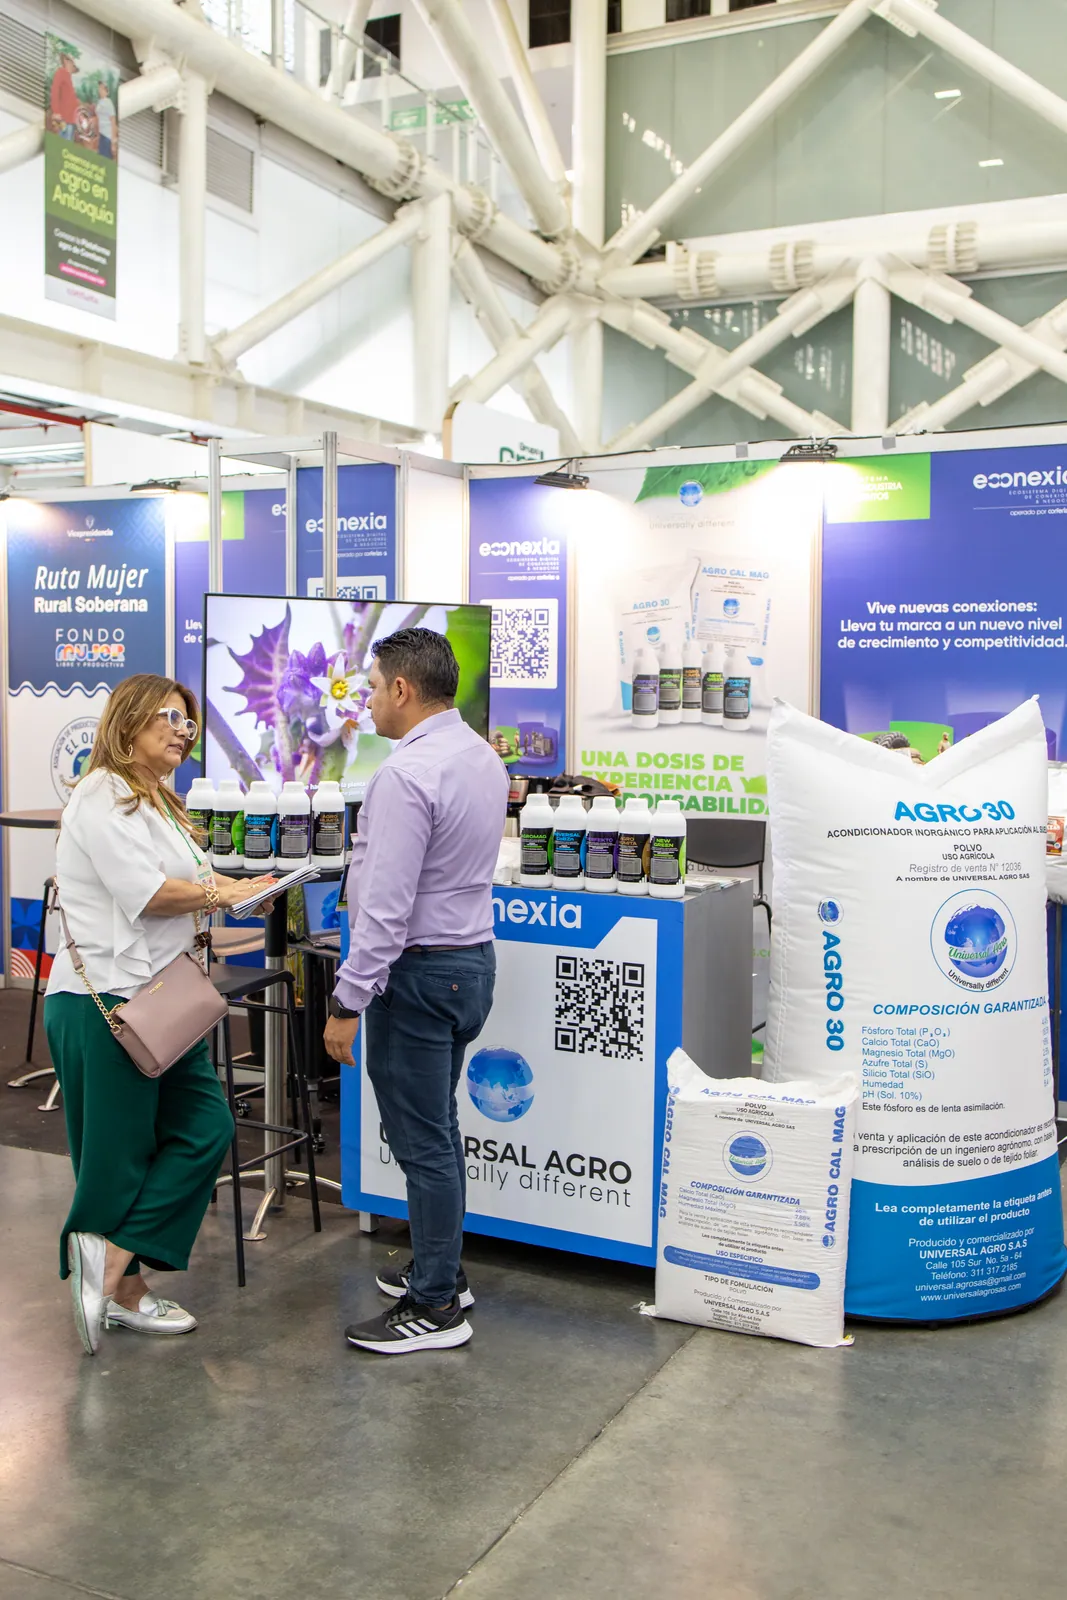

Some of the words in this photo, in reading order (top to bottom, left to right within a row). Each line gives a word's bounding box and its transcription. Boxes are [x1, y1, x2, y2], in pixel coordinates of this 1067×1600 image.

[59, 169, 90, 192] agro
[92, 184, 108, 202] en
[52, 184, 114, 225] Antioquia
[34, 566, 80, 590] Ruta
[87, 564, 148, 596] Mujer
[702, 567, 727, 575] AGRO
[730, 569, 746, 577] CAL
[34, 596, 72, 613] Rural
[75, 596, 148, 613] Soberana
[633, 600, 658, 610] AGRO
[867, 602, 896, 614] Vive
[900, 603, 949, 613] nuevas
[952, 600, 1037, 613] conexiones:
[840, 619, 876, 632] Lleva
[879, 620, 892, 631] tu
[897, 620, 942, 631] marca
[946, 620, 954, 630] a
[958, 620, 976, 630] un
[980, 619, 1024, 630] nuevo
[1028, 617, 1062, 630] nivel
[56, 628, 124, 642] FONDO
[838, 637, 855, 648] de
[859, 636, 939, 648] crecimiento
[942, 638, 950, 650] y
[954, 635, 1067, 650] competitividad.
[581, 750, 629, 767] UNA
[636, 752, 705, 769] DOSIS
[713, 754, 744, 772] DE
[894, 800, 982, 822] AGRO
[982, 800, 1015, 821] 30
[827, 828, 913, 838] ACONDICIONADOR
[915, 826, 971, 837] INORGÁNICO
[973, 827, 994, 836] PARA
[995, 825, 1032, 836] APLICACIÓN
[954, 844, 982, 852] POLVO
[960, 851, 994, 860] AGRÍCOLA
[909, 863, 948, 874] Registro
[950, 864, 962, 872] de
[965, 864, 987, 872] venta
[989, 863, 998, 872] N°
[1001, 862, 1021, 871] 12036
[492, 896, 582, 929] nexia
[948, 946, 990, 961] Universal
[822, 930, 844, 1011] AGRO
[948, 968, 984, 990] Universally
[986, 968, 1009, 989] different
[873, 1002, 980, 1016] COMPOSICIÓN
[983, 996, 1046, 1014] GARANTIZADA
[826, 1018, 844, 1051] 30
[862, 1026, 894, 1036] Fósforo
[896, 1027, 917, 1036] Total
[862, 1038, 888, 1046] Calcio
[891, 1038, 911, 1046] Total
[914, 1039, 940, 1048] (CaO)
[862, 1048, 903, 1058] Magnesio
[906, 1049, 926, 1057] Total
[928, 1049, 955, 1059] (MgO)
[862, 1059, 890, 1067] Azufre
[892, 1060, 912, 1068] Total
[915, 1060, 928, 1069] (S)
[862, 1069, 887, 1078] Silicio
[890, 1070, 910, 1078] Total
[912, 1071, 935, 1080] (SiO)
[862, 1080, 904, 1088] Humedad
[862, 1091, 874, 1099] pH
[877, 1091, 896, 1100] (Sol.
[900, 1091, 922, 1101] 10%)
[745, 1102, 766, 1110] POLVO
[664, 1097, 676, 1143] AGRO
[832, 1106, 846, 1143] MAG
[544, 1150, 632, 1184] AGRO
[662, 1148, 671, 1174] CAL
[829, 1148, 842, 1179] CAL
[520, 1170, 631, 1207] different
[679, 1187, 694, 1195] Calcio
[690, 1181, 744, 1196] COMPOSICIÓN
[746, 1190, 800, 1205] GARANTIZADA
[659, 1183, 668, 1218] MAG
[678, 1194, 704, 1203] Magnesio
[705, 1198, 717, 1206] Total
[678, 1200, 704, 1209] Humedad
[824, 1184, 839, 1232] AGRO
[875, 1202, 897, 1213] Lea
[901, 1202, 990, 1215] completamente
[993, 1200, 1001, 1209] la
[1004, 1194, 1035, 1208] etiqueta
[1037, 1187, 1052, 1200] antes
[919, 1216, 933, 1226] de
[938, 1215, 975, 1225] utilizar
[979, 1214, 988, 1223] el
[991, 1208, 1030, 1224] producto
[908, 1238, 956, 1248] Producido
[959, 1239, 964, 1247] y
[966, 1231, 1022, 1245] comercializado
[1024, 1226, 1035, 1237] por
[919, 1249, 978, 1259] UNIVERSAL
[980, 1244, 1006, 1255] AGRO
[1008, 1239, 1027, 1251] S.A.S
[926, 1260, 948, 1270] Calle
[951, 1260, 965, 1268] 105
[968, 1258, 981, 1267] Sur
[986, 1256, 998, 1264] No.
[1000, 1254, 1008, 1262] 5a
[1014, 1252, 1022, 1260] 64
[704, 1275, 719, 1283] TIPO
[932, 1271, 968, 1280] Teléfono:
[971, 1268, 985, 1277] 311
[987, 1266, 999, 1275] 317
[1001, 1263, 1018, 1273] 2185
[915, 1271, 1026, 1292] universal.agrosas@gmail.com
[921, 1282, 1021, 1302] www.universalagrosas.com
[704, 1299, 736, 1311] UNIVERSAL
[738, 1306, 754, 1314] AGRO
